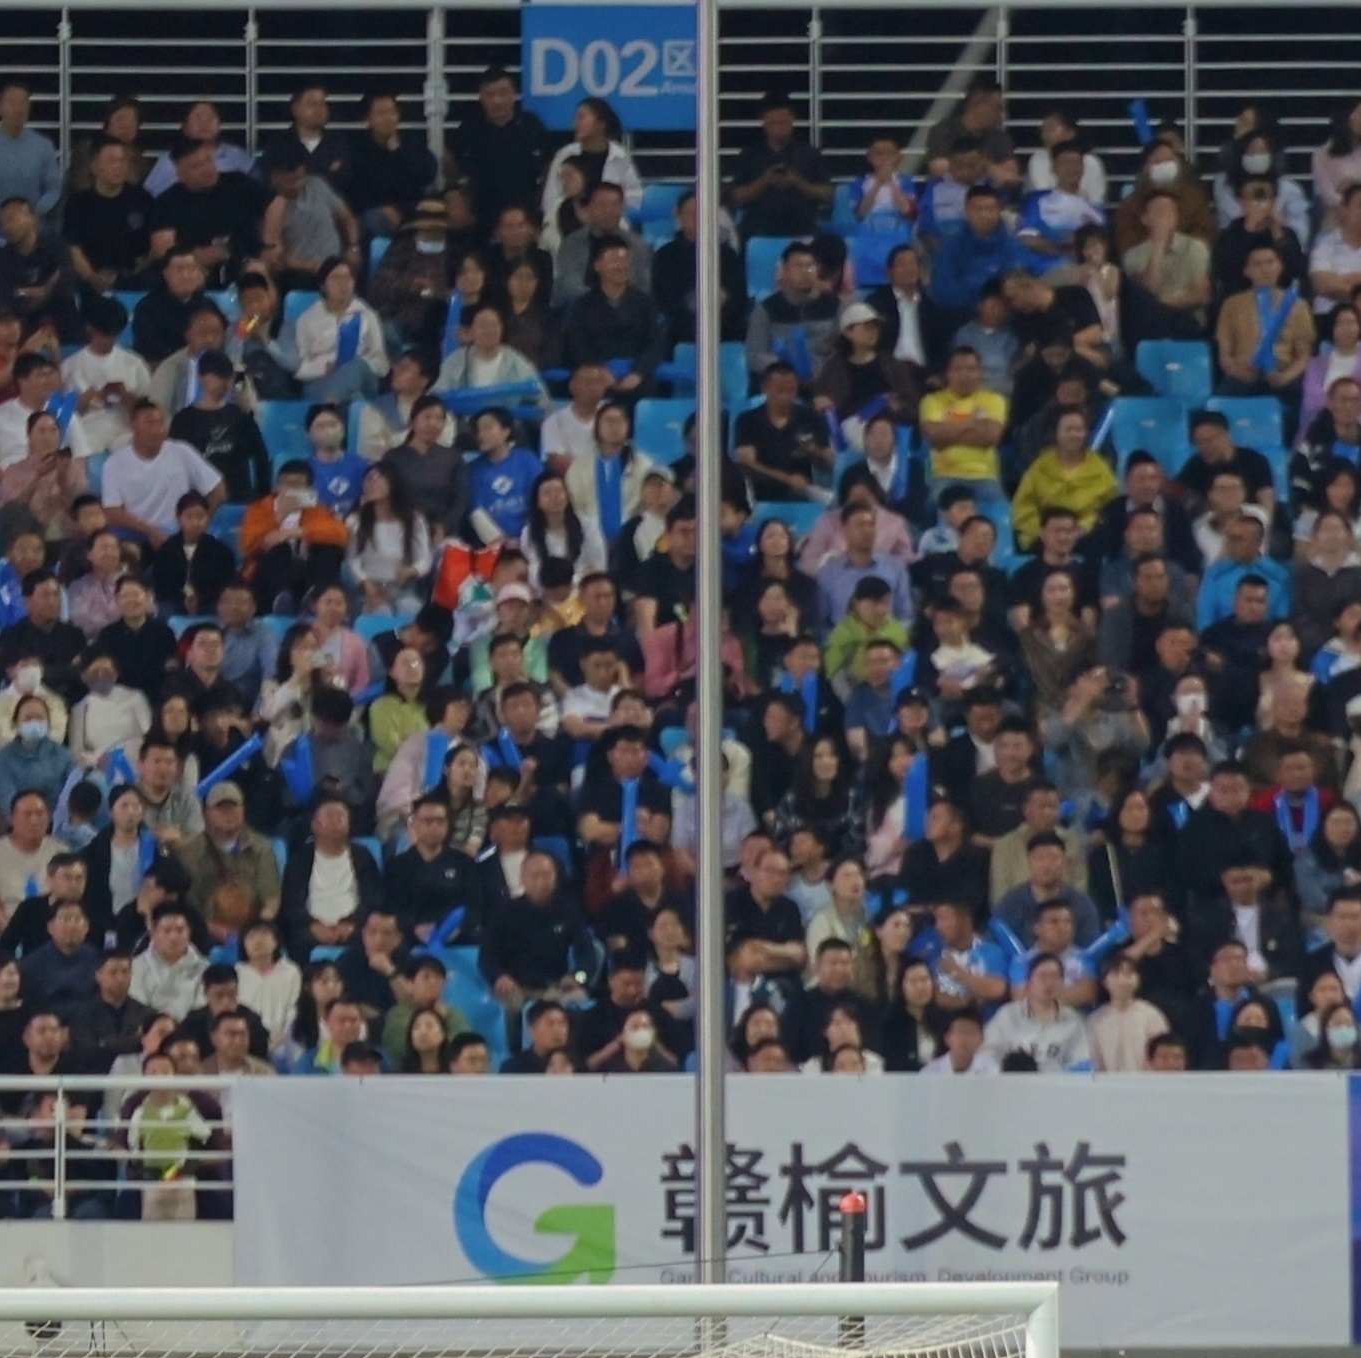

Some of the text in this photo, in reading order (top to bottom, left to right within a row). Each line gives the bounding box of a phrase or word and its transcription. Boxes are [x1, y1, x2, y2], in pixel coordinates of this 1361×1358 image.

[659, 1140, 1130, 1254] 赣榆文旅
[864, 1269, 927, 1284] ourism
[1069, 1266, 1130, 1285] Group
